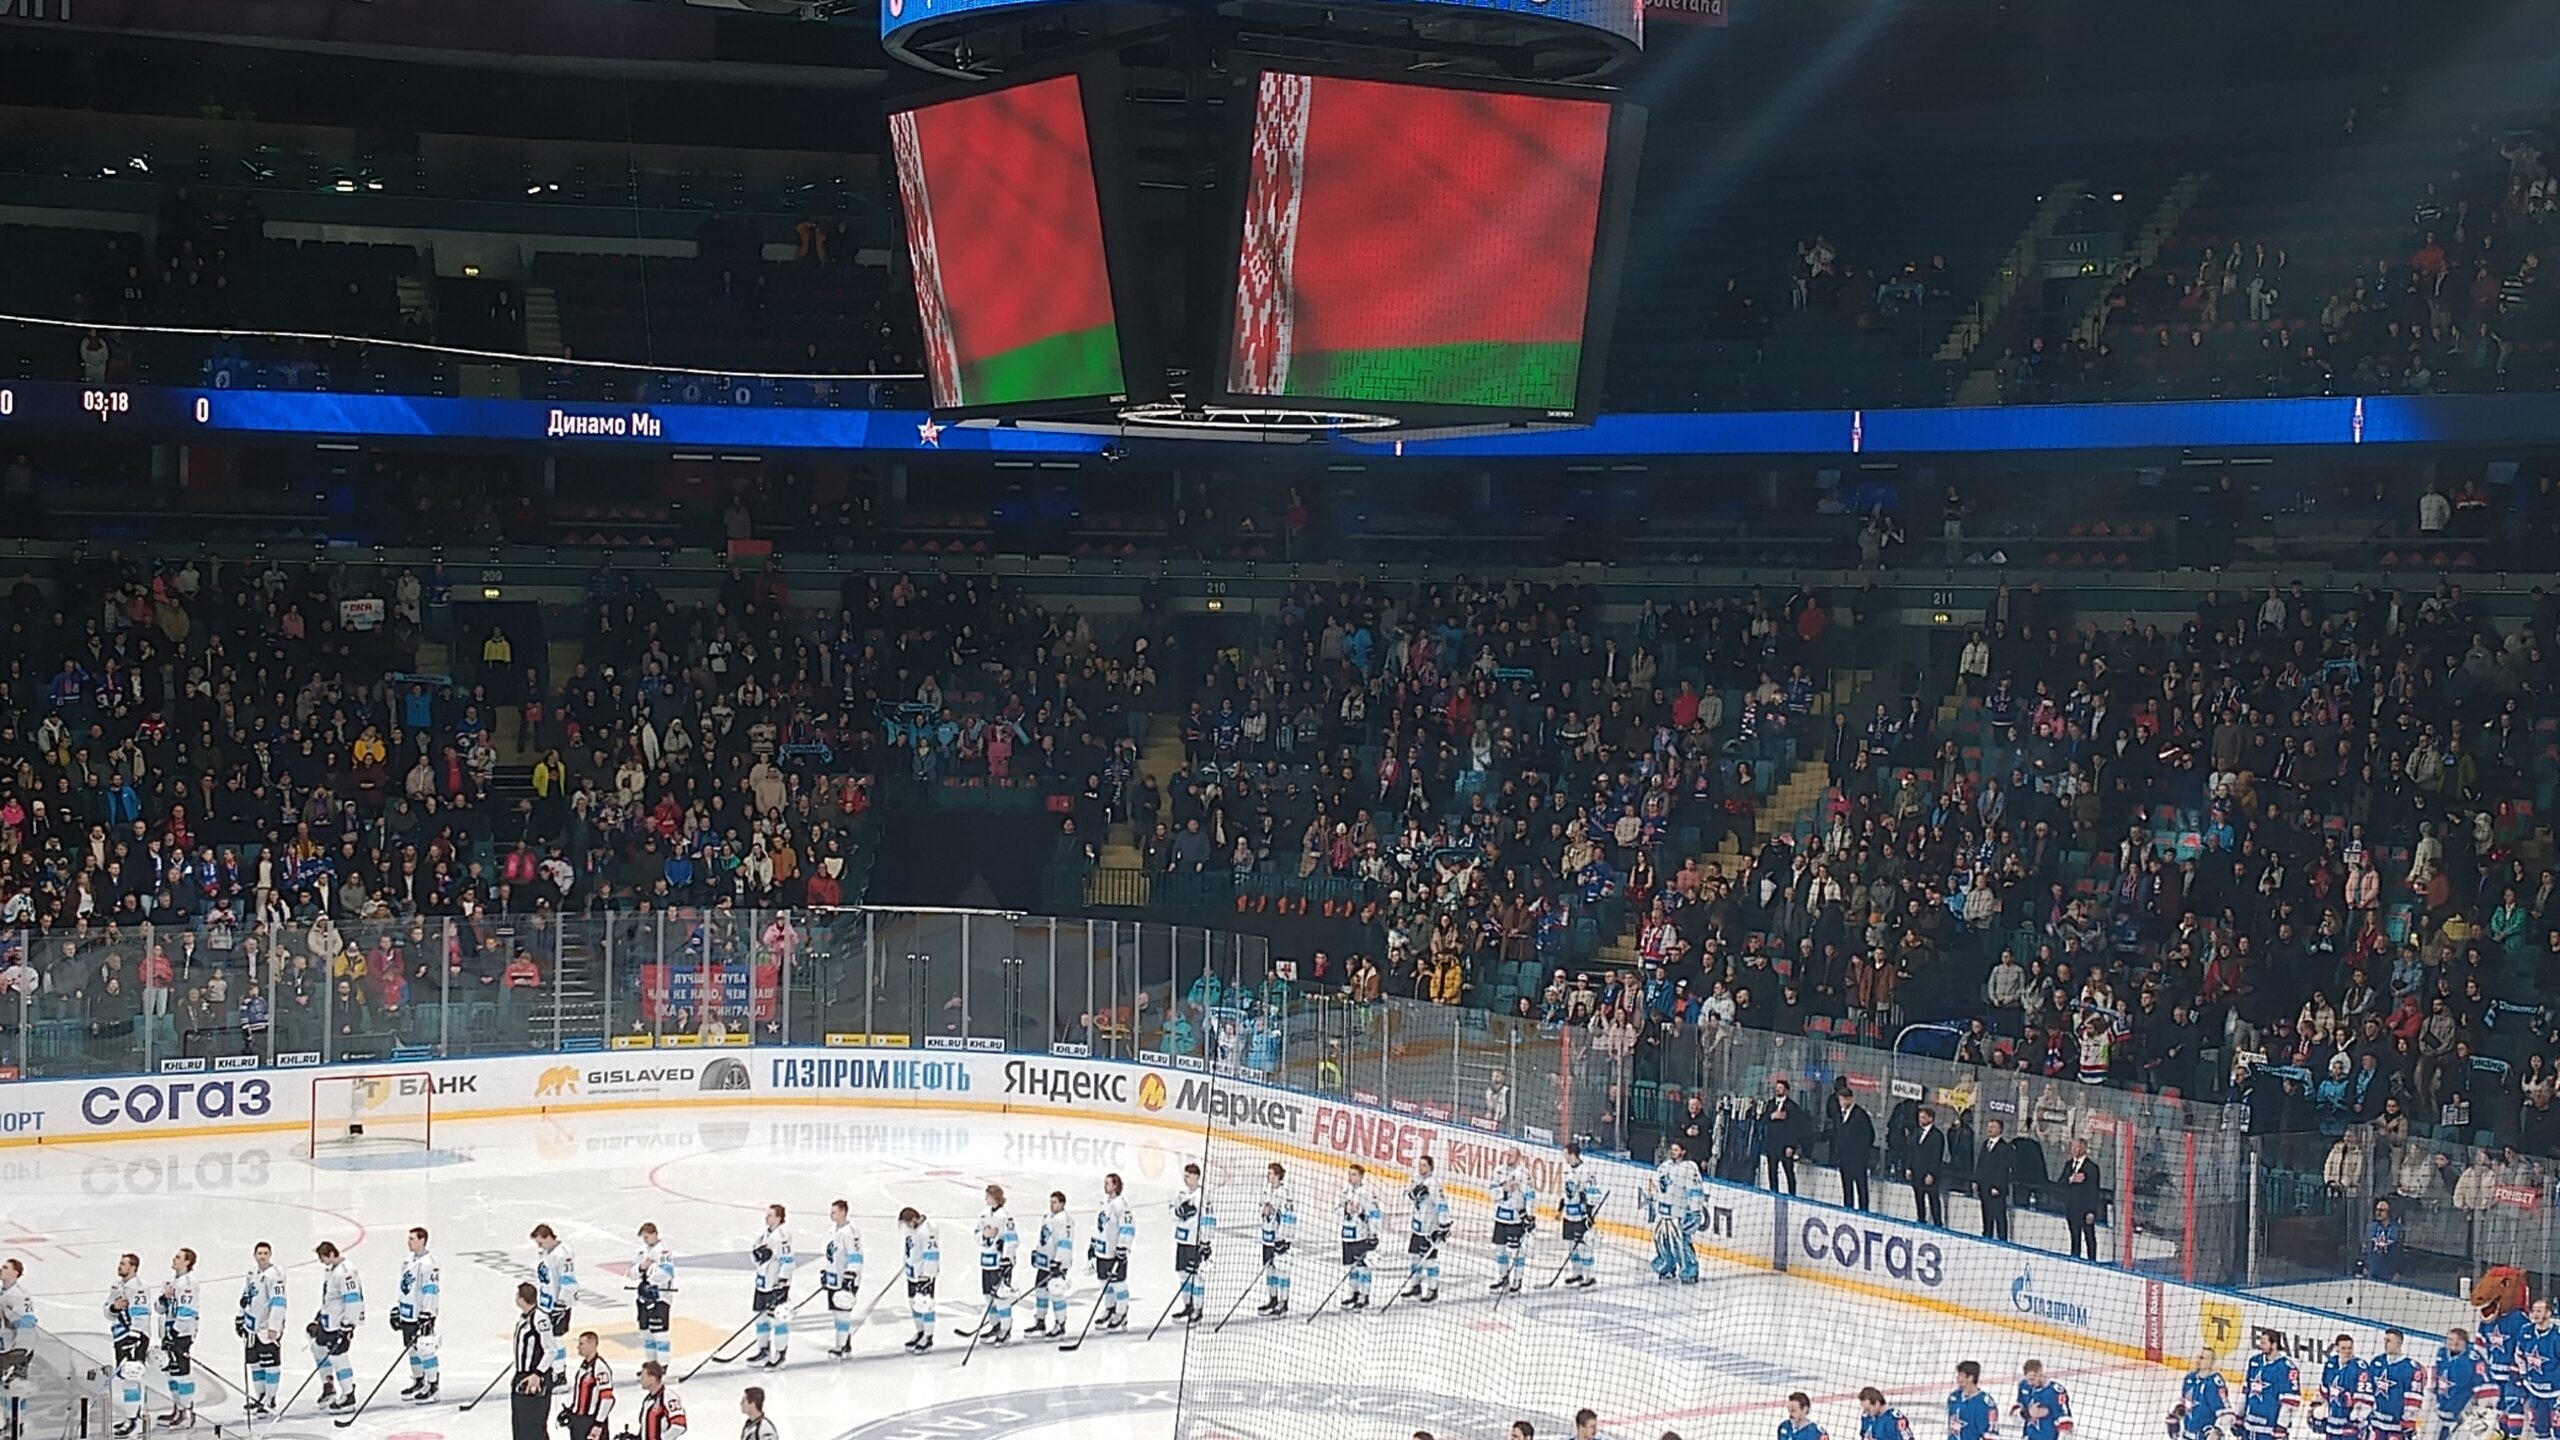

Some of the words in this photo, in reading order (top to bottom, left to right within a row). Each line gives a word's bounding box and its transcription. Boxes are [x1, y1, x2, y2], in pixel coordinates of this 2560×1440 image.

[84, 391, 129, 411] 03:18
[196, 398, 209, 422] 0
[548, 410, 625, 437] Динамо
[632, 412, 661, 438] Мн
[482, 571, 503, 582] 209
[1207, 582, 1226, 594] 210
[1933, 592, 1953, 605] 211
[673, 973, 704, 984] ЛУЧШ
[714, 973, 747, 984] КЛУБА
[673, 989, 687, 999] НЕ
[690, 988, 723, 1001] НАО,
[726, 988, 746, 999] ЧЕМ
[927, 1039, 961, 1048] KHL.RU
[969, 1040, 1003, 1049] KHL.RU
[1056, 1046, 1086, 1056] KHL.RU
[164, 1060, 203, 1070] KHL.RU
[218, 1058, 256, 1069] KHL.RU
[280, 1054, 318, 1066] KHL.RU
[1141, 1054, 1168, 1064] KHL.RU
[1178, 1059, 1202, 1069] KHL.RU
[588, 1069, 694, 1084] GISLAVED
[773, 1059, 971, 1091] ГАЗПРОМНЕФТЬ
[400, 1075, 477, 1096] БАНК
[1894, 1084, 1921, 1096] KHL.RU
[1003, 1060, 1127, 1103] Яндекс
[1175, 1078, 1303, 1133] Маркет
[0, 1111, 45, 1132] ОРТ
[1312, 1107, 1437, 1168] FONBET
[2495, 1188, 2535, 1204] FONBET
[346, 1281, 356, 1291] 10
[135, 1295, 147, 1305] 23
[181, 1294, 193, 1304] 67
[2032, 1297, 2088, 1326] ГАЗПРОМ
[2357, 1382, 2373, 1393] 22
